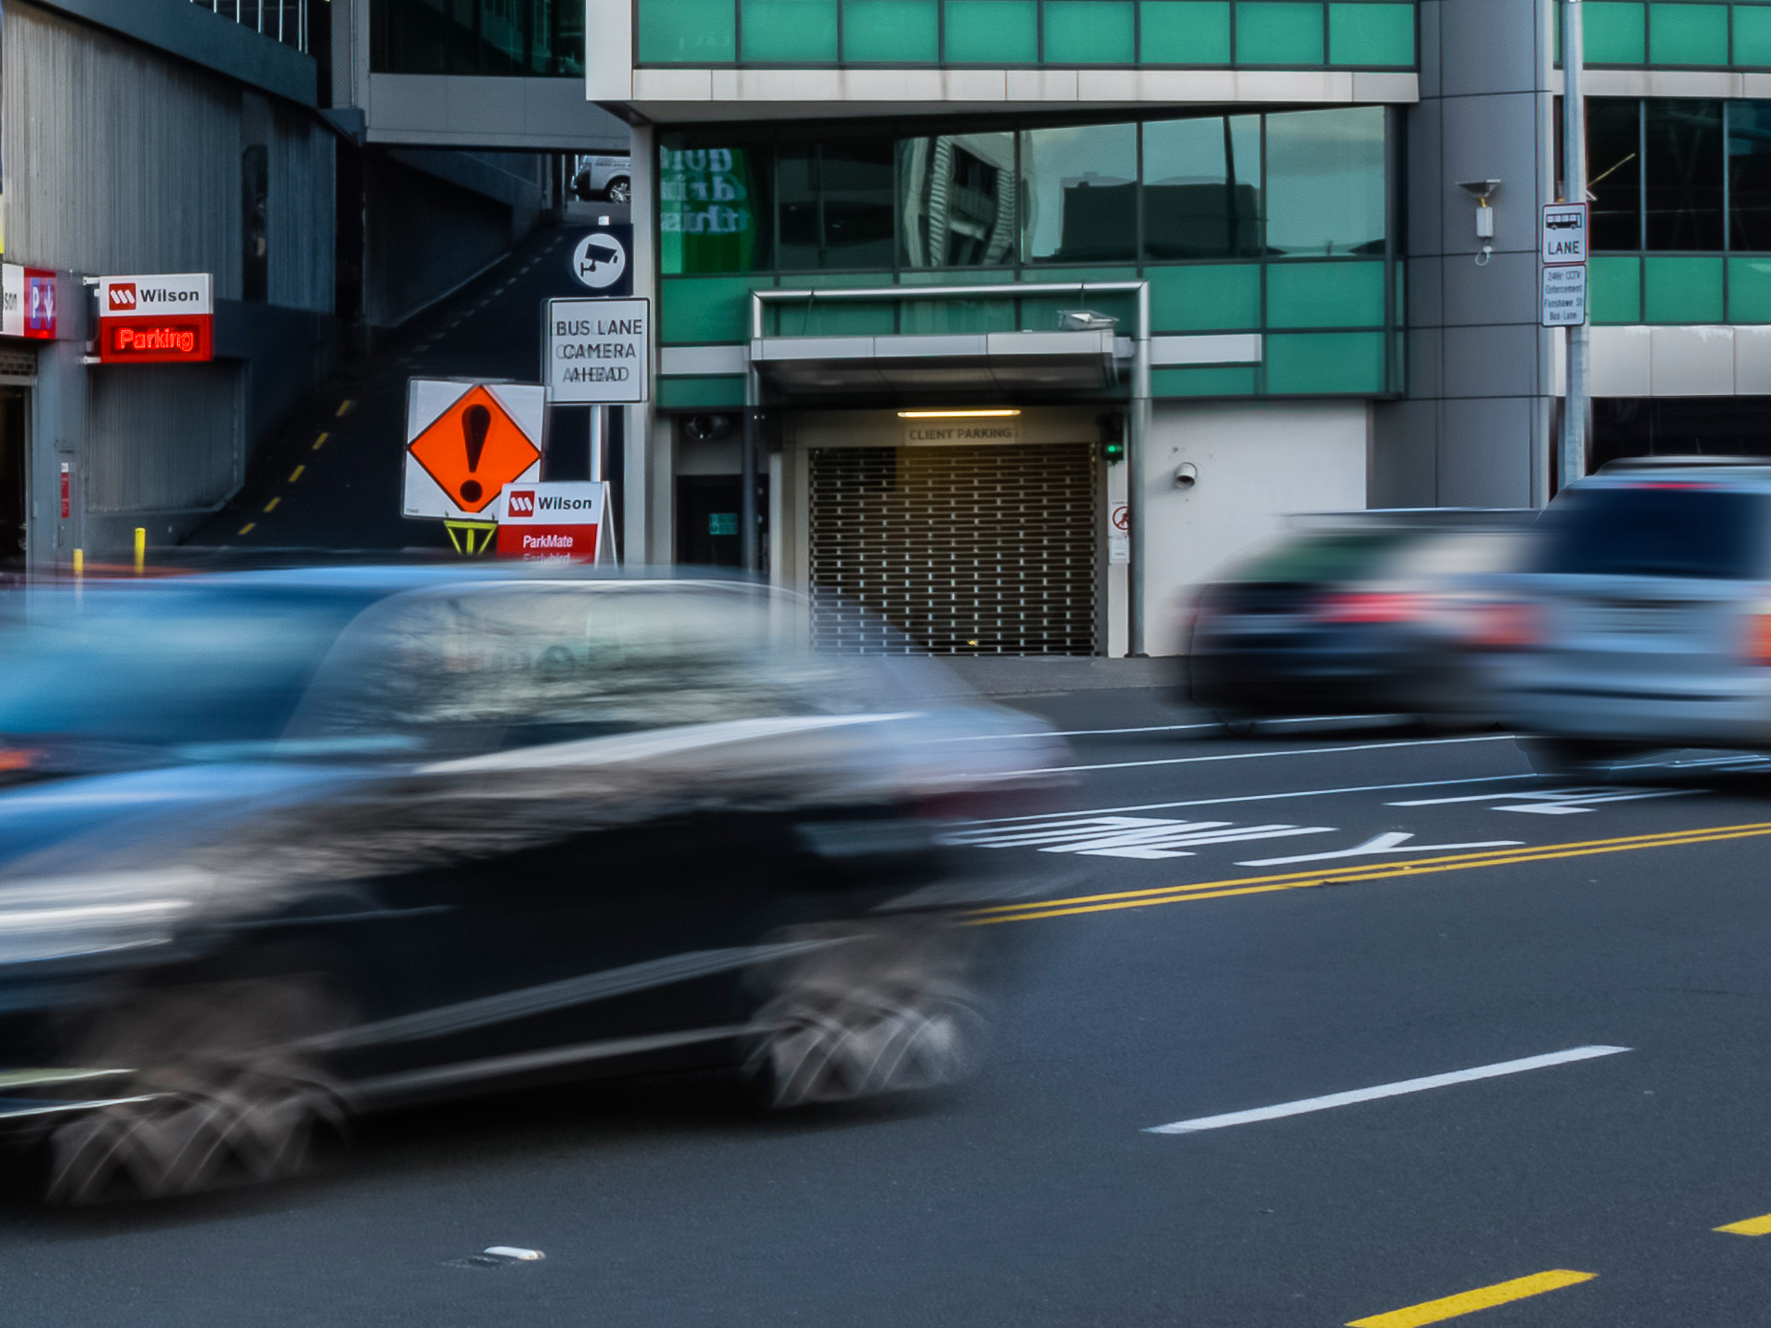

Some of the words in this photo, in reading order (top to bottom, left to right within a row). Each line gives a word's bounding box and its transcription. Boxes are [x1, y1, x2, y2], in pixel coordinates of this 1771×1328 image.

[1548, 241, 1580, 255] LANE
[3, 292, 18, 311] son
[140, 288, 200, 303] Wilson
[555, 320, 590, 336] BUS
[597, 319, 643, 335] LANE
[118, 327, 195, 352] Parking
[561, 343, 637, 359] CAMERA
[565, 367, 629, 382] AHEAD
[908, 428, 954, 441] CLIENT
[957, 427, 1013, 440] PARKING
[538, 496, 592, 510] Wilson
[522, 534, 574, 549] ParkMate
